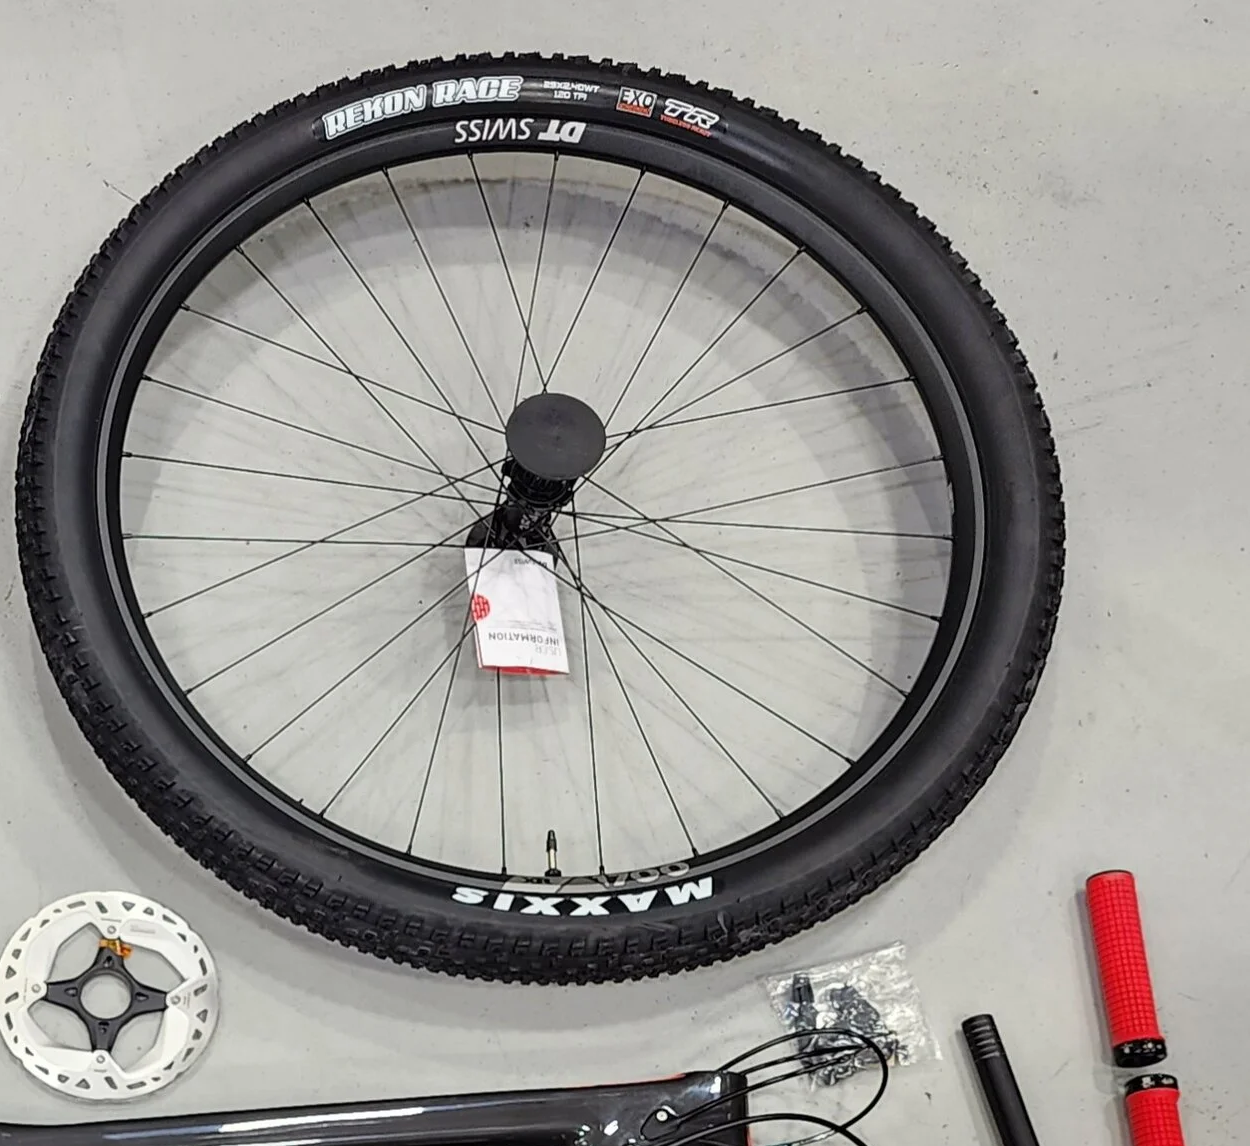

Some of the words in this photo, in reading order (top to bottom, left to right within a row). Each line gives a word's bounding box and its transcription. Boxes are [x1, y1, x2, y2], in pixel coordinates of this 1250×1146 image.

[553, 90, 571, 99] 120
[573, 91, 587, 101] TPI
[621, 87, 655, 108] EXO
[321, 84, 427, 141] REKON
[431, 76, 524, 108] RACE
[664, 98, 720, 130] TR
[454, 118, 535, 143] SWISS
[537, 121, 588, 145] DT
[488, 631, 560, 646] INFORMATION
[452, 876, 713, 916] MAXXIS
